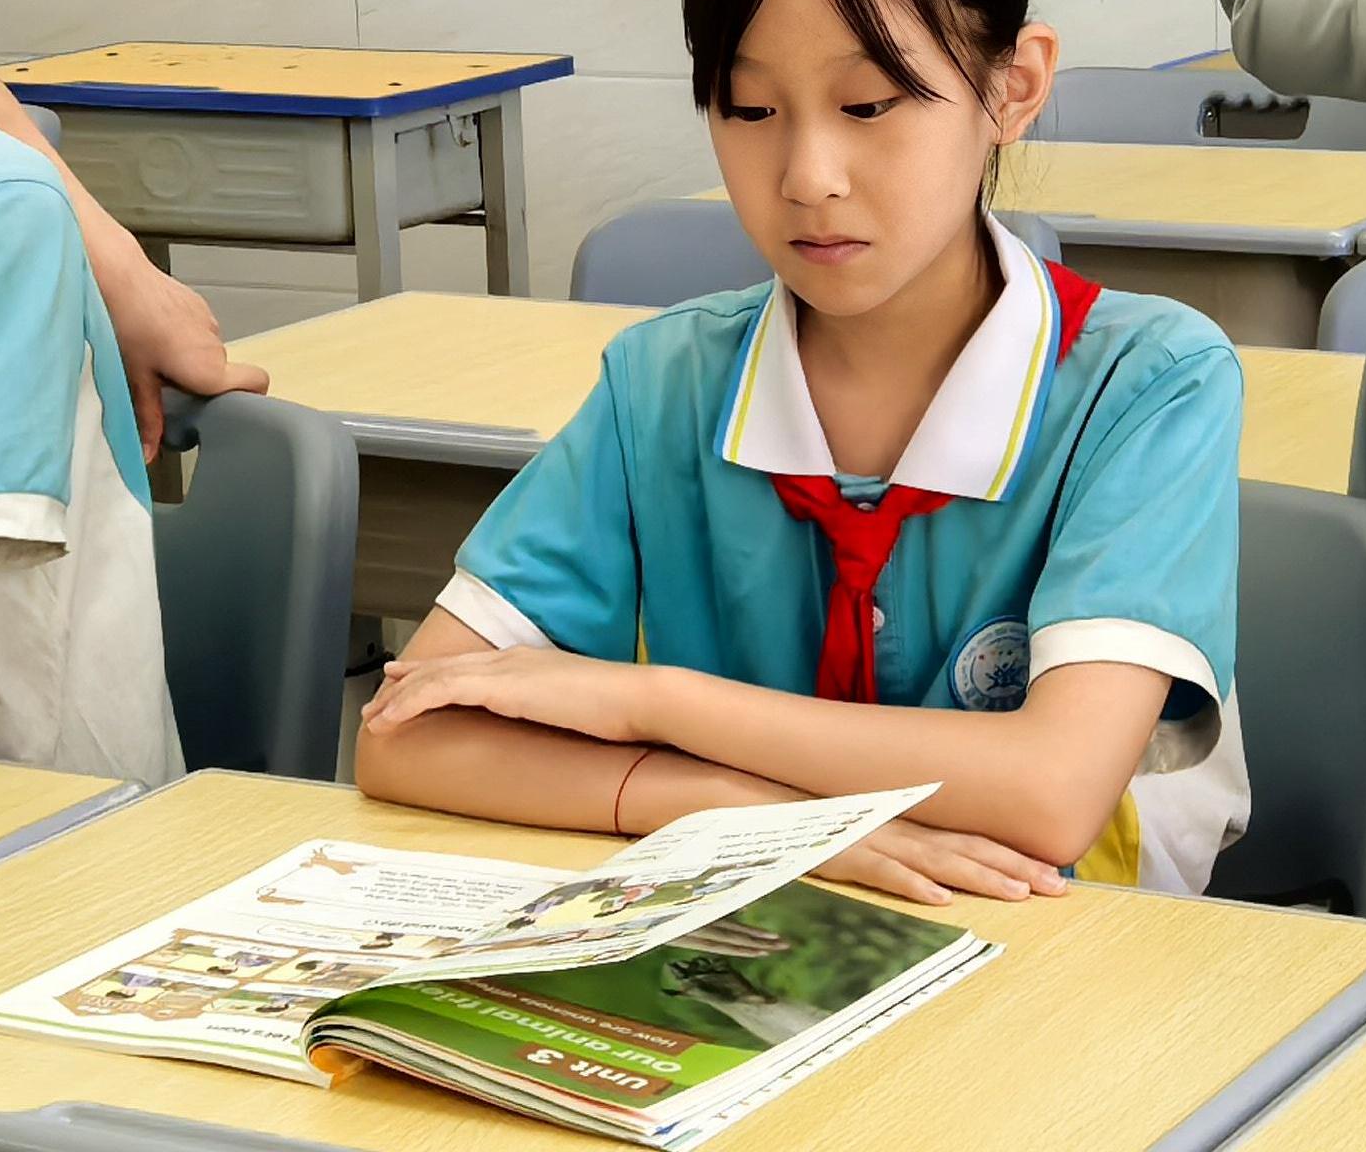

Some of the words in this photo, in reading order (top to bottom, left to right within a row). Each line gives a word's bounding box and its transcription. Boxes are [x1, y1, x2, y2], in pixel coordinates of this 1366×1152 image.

[477, 1006, 612, 1052] animal
[526, 1048, 564, 1066] 3
[610, 1049, 682, 1073] Our
[569, 1060, 649, 1090] Unit
